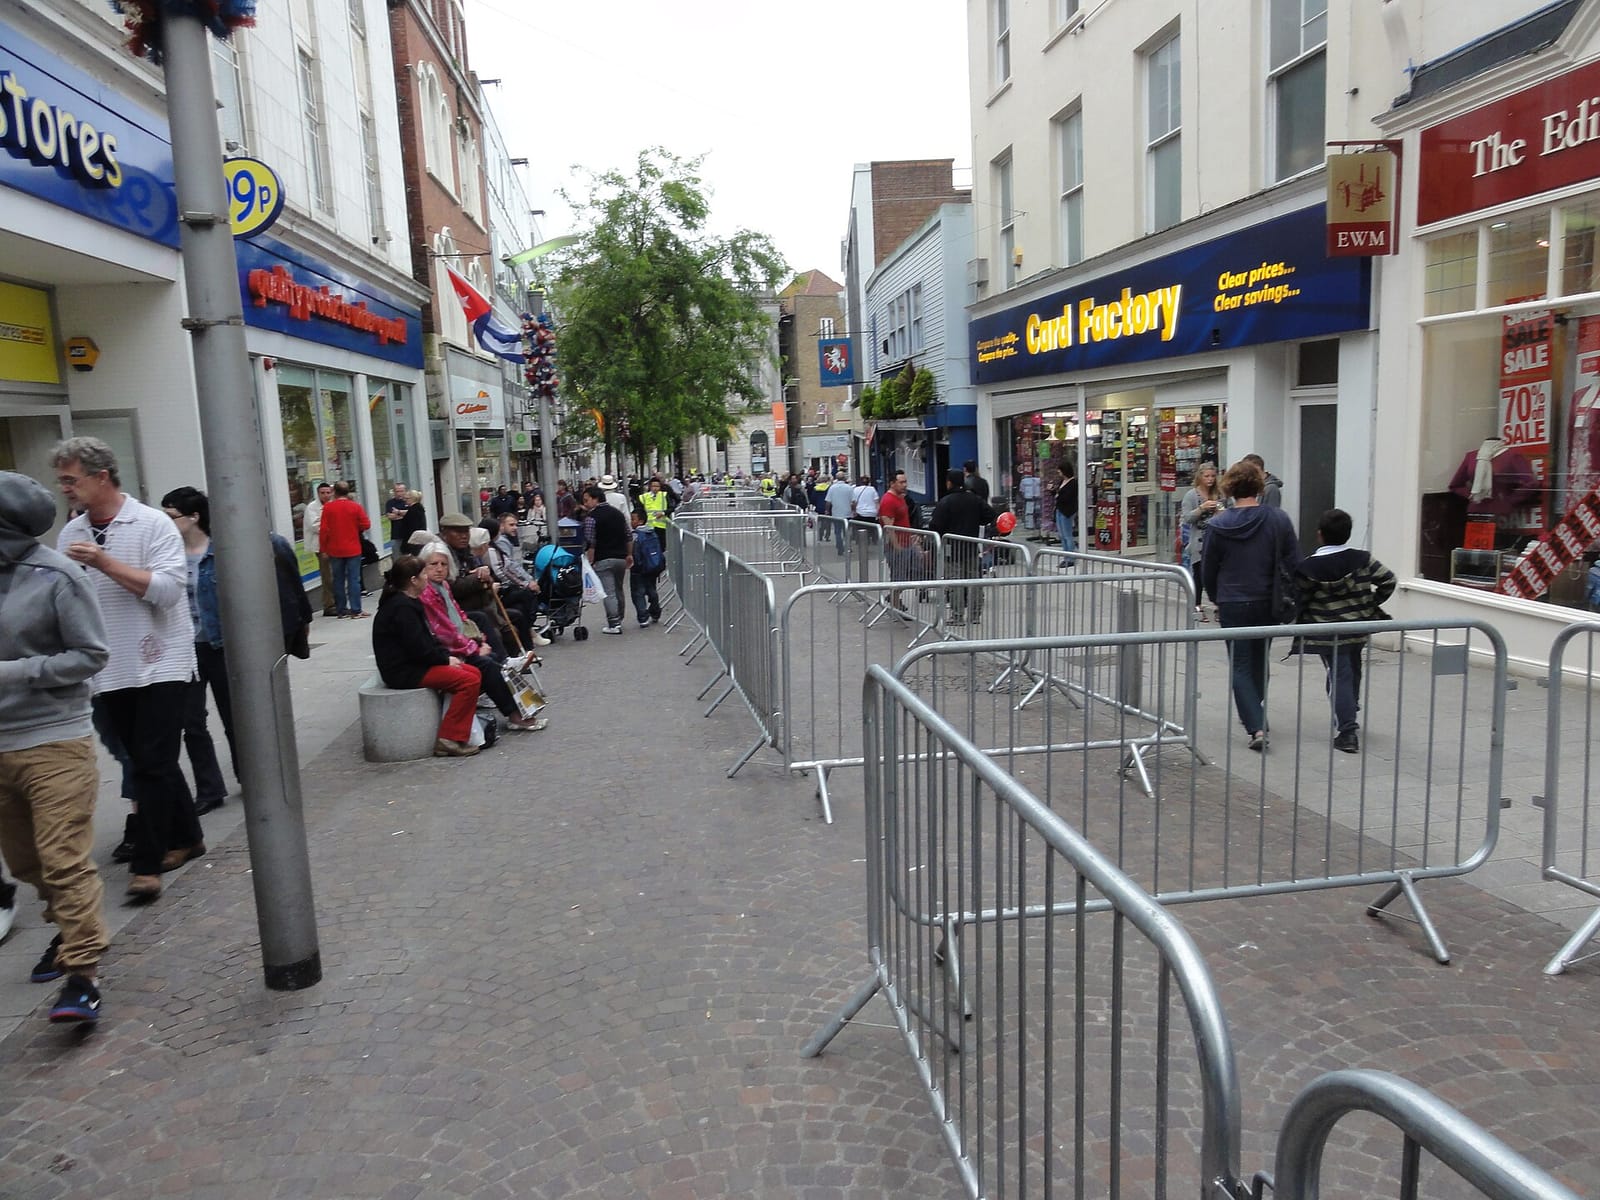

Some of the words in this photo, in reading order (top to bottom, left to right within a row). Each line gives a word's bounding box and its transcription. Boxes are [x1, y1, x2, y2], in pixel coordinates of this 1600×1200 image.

[1469, 131, 1527, 178] The
[1539, 96, 1600, 156] Edi
[1337, 230, 1385, 248] EWM
[1218, 271, 1248, 291] Clear
[1247, 262, 1296, 288] prices...
[1213, 293, 1243, 313] Clear
[1243, 284, 1300, 306] savings...
[1026, 303, 1072, 355] Card
[1079, 284, 1182, 344] Factory
[1505, 320, 1549, 349] SALE
[1503, 344, 1549, 374] SALE
[1502, 420, 1545, 446] SALE
[1574, 503, 1600, 538] SALE
[1555, 523, 1583, 557] SALE
[1536, 541, 1564, 576] SALE
[1519, 560, 1545, 593] SALE
